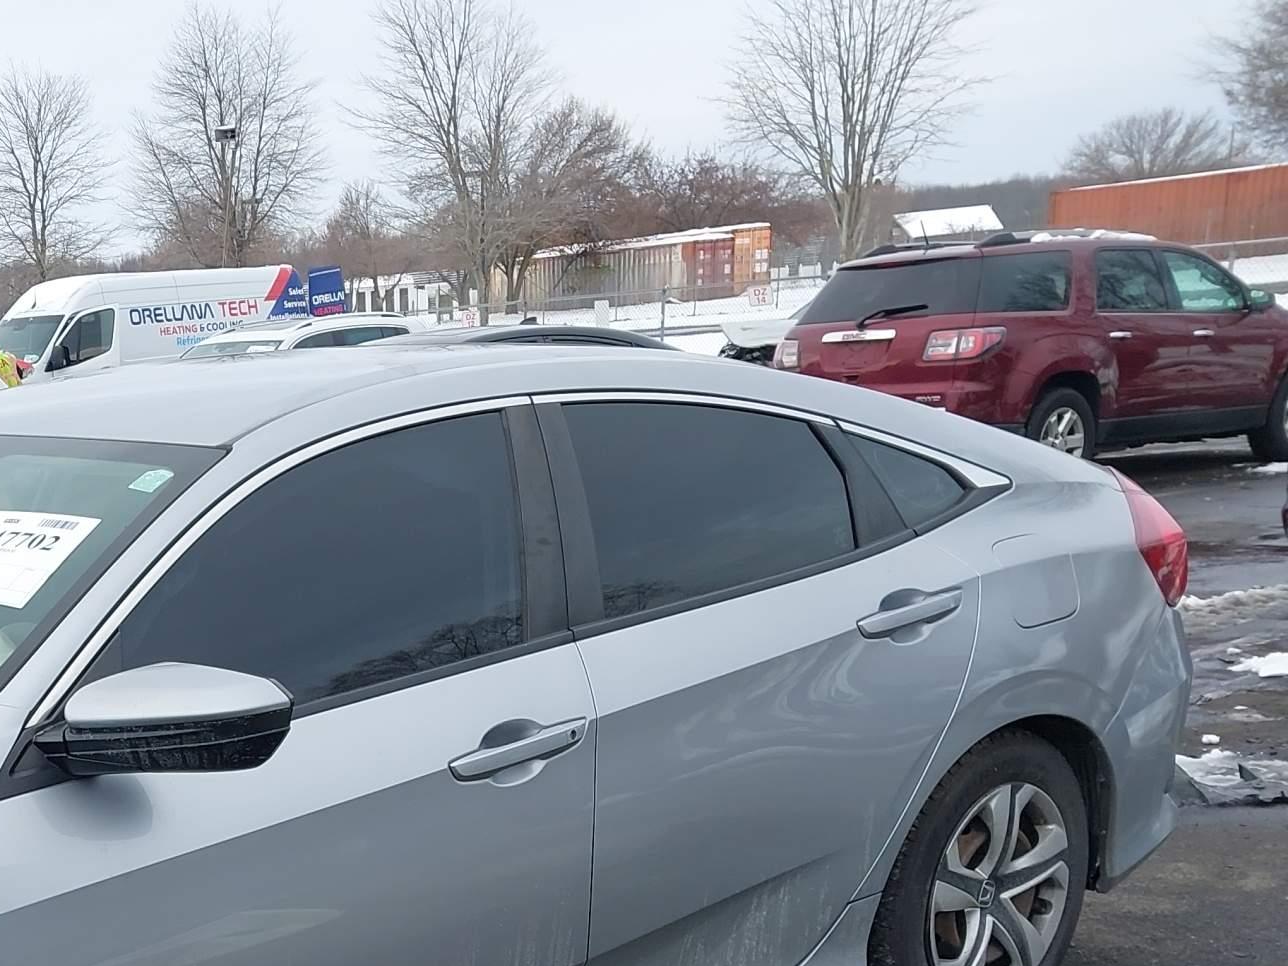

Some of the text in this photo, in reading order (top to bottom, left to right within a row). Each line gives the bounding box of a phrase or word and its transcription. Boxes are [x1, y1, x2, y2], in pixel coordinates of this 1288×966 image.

[129, 299, 259, 325] ORELLANA TECH
[159, 324, 198, 336] HEATING
[199, 323, 205, 332] &
